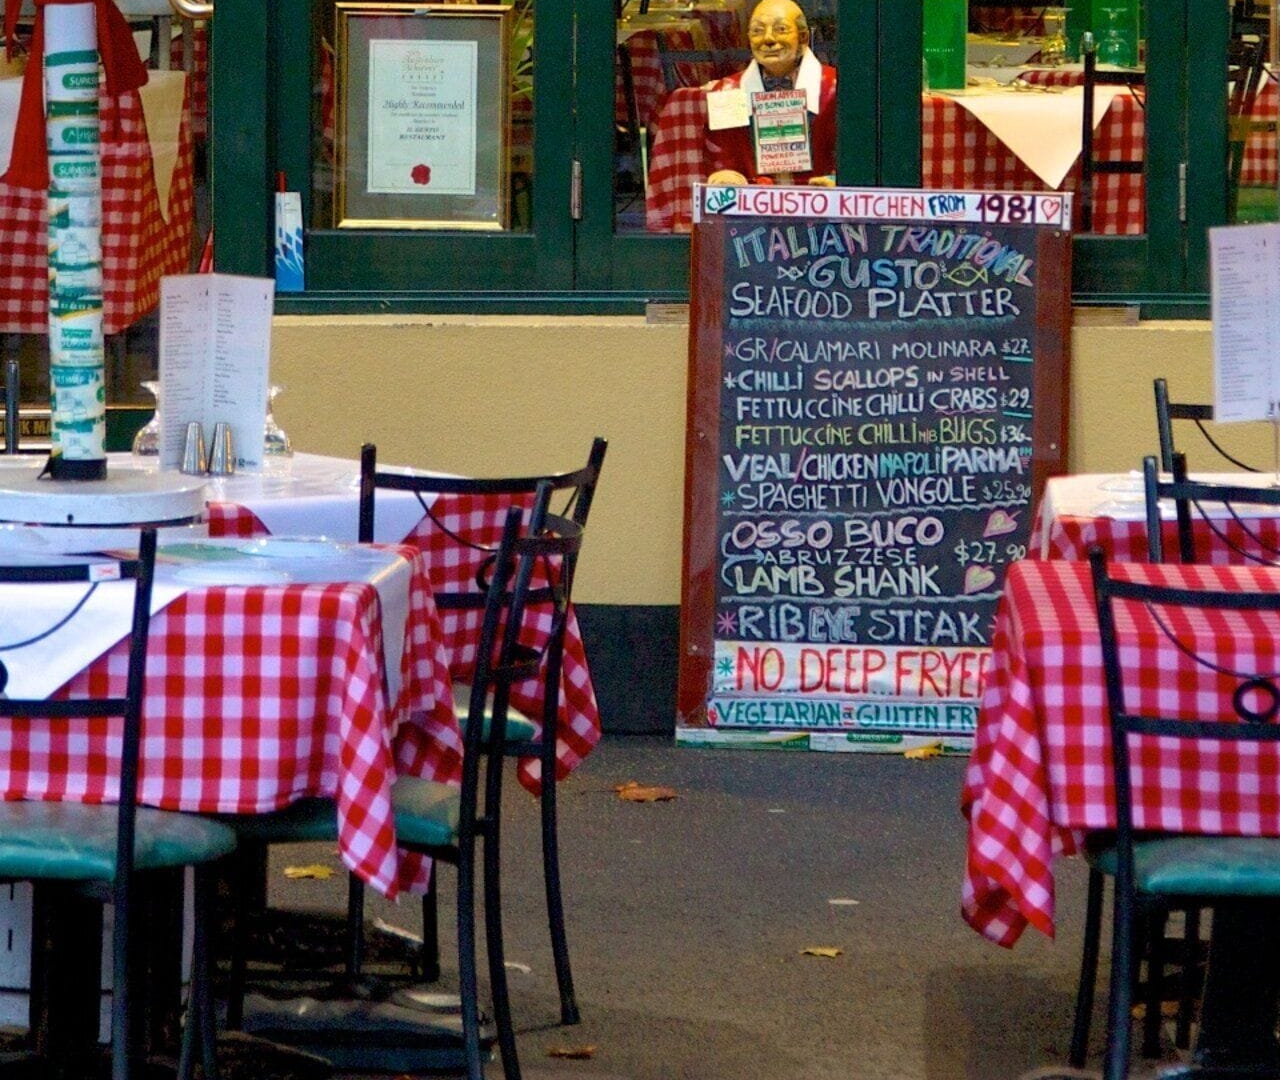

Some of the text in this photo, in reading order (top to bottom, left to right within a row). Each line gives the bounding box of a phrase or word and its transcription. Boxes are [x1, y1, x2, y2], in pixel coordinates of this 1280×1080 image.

[753, 191, 828, 215] GUSTO
[839, 194, 925, 217] KITCHEN
[928, 195, 966, 217] FROM
[974, 194, 1037, 223] 1981
[729, 222, 1034, 288] ITALIAN TRADITIONAL
[807, 256, 941, 289] GUSTO
[729, 282, 1020, 318] SEAFOOD PLATTER
[891, 340, 997, 360] MOLINARA
[737, 365, 1010, 391] CHILLI SCALLOPS IN SHELL
[737, 388, 997, 420] FETTUCCINE CHILLI CRABS
[735, 423, 853, 449] FETTUCCINE
[858, 420, 917, 447] CHILLI
[939, 419, 997, 445] BUGS
[879, 448, 940, 475] NAPOLI
[941, 446, 1022, 475] PARMA
[737, 482, 868, 511] SPAGHETTI
[876, 476, 976, 508] VONGOLE
[731, 517, 944, 550] OSSO BUCO
[763, 548, 917, 566] ABRUZZESE
[735, 565, 942, 596] LAMB SHANK
[868, 609, 986, 643] STEAK
[737, 646, 785, 693] NO
[800, 648, 886, 695] DEEP
[719, 701, 842, 727] VEGETARIAN
[856, 702, 938, 729] GLUTEN
